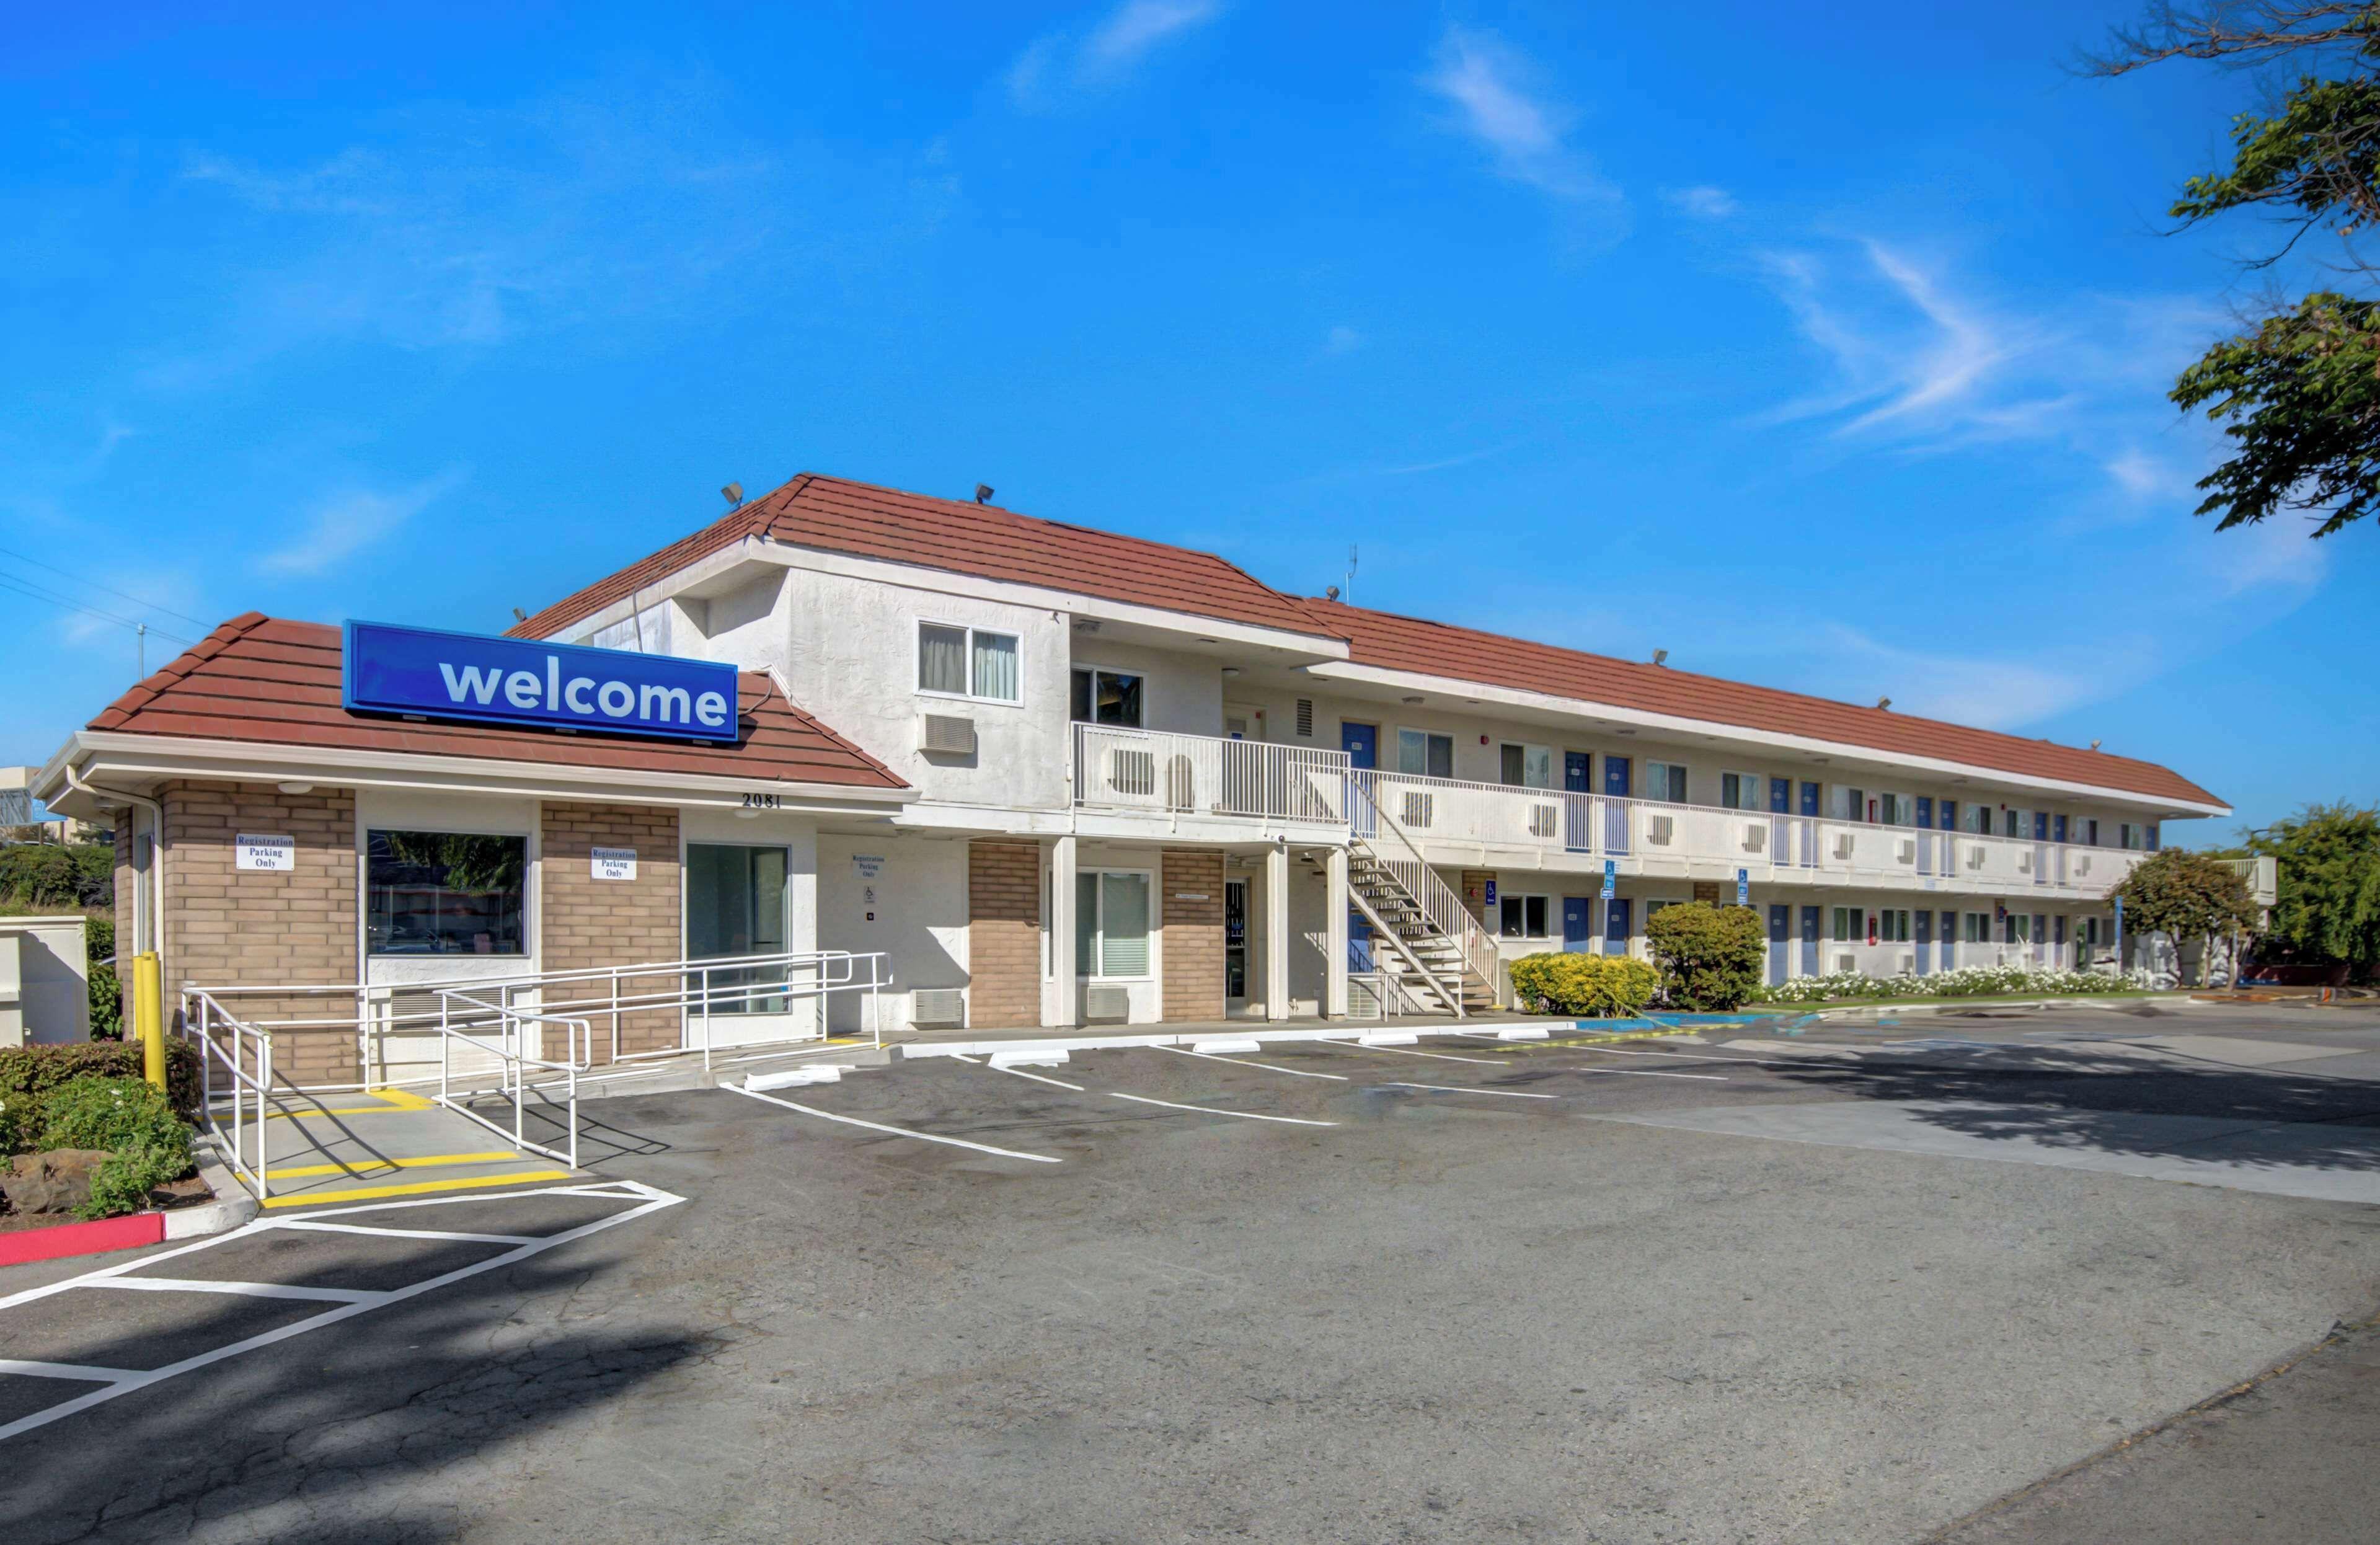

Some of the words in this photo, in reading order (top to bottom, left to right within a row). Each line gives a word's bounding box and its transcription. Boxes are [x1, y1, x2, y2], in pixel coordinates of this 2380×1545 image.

[438, 655, 728, 727] welcome
[743, 793, 780, 808] 2081
[238, 836, 293, 848] Registration
[250, 848, 283, 858] Parking
[593, 849, 635, 859] Registration
[255, 858, 276, 868] Only
[602, 859, 627, 869] Parking
[606, 869, 622, 878] Only
